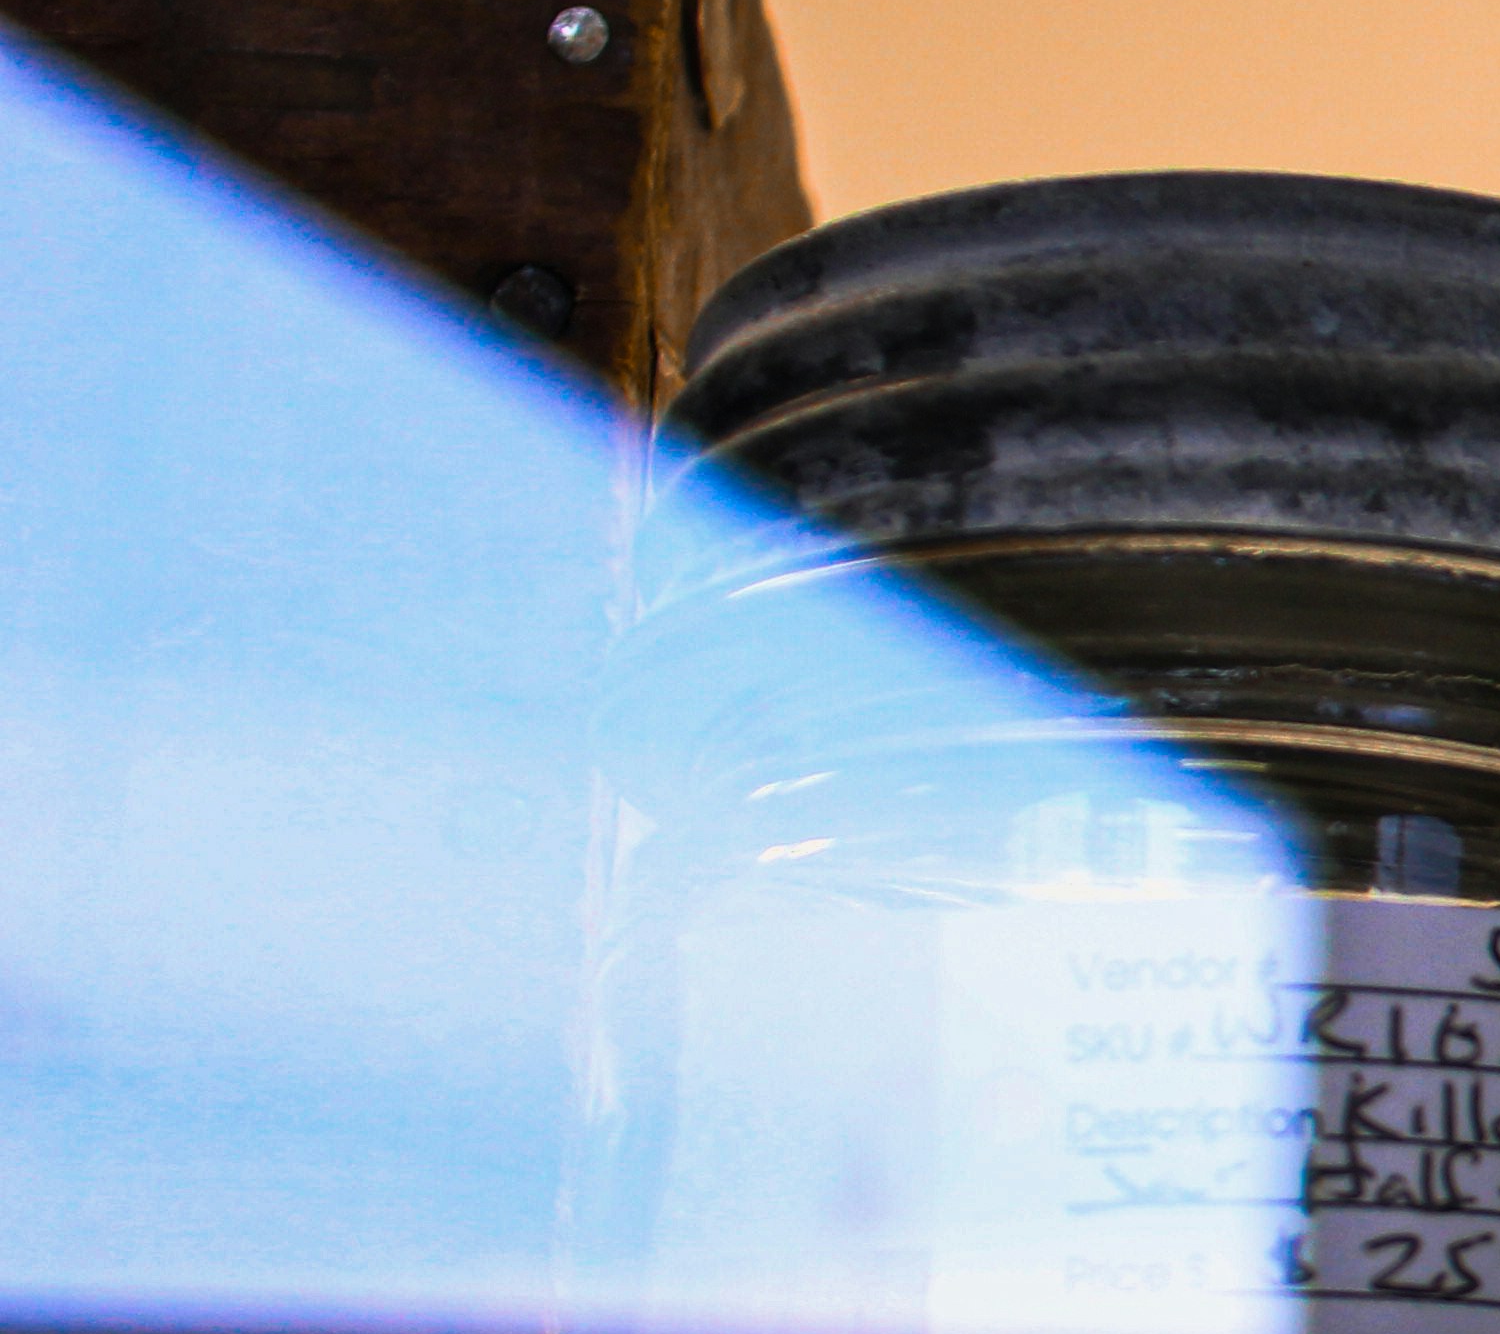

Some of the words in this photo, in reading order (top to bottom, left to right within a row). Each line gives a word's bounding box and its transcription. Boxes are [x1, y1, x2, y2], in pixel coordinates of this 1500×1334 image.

[1066, 950, 1245, 995] Vendor
[1066, 1021, 1157, 1065] SKU
[1066, 1099, 1325, 1145] Description
